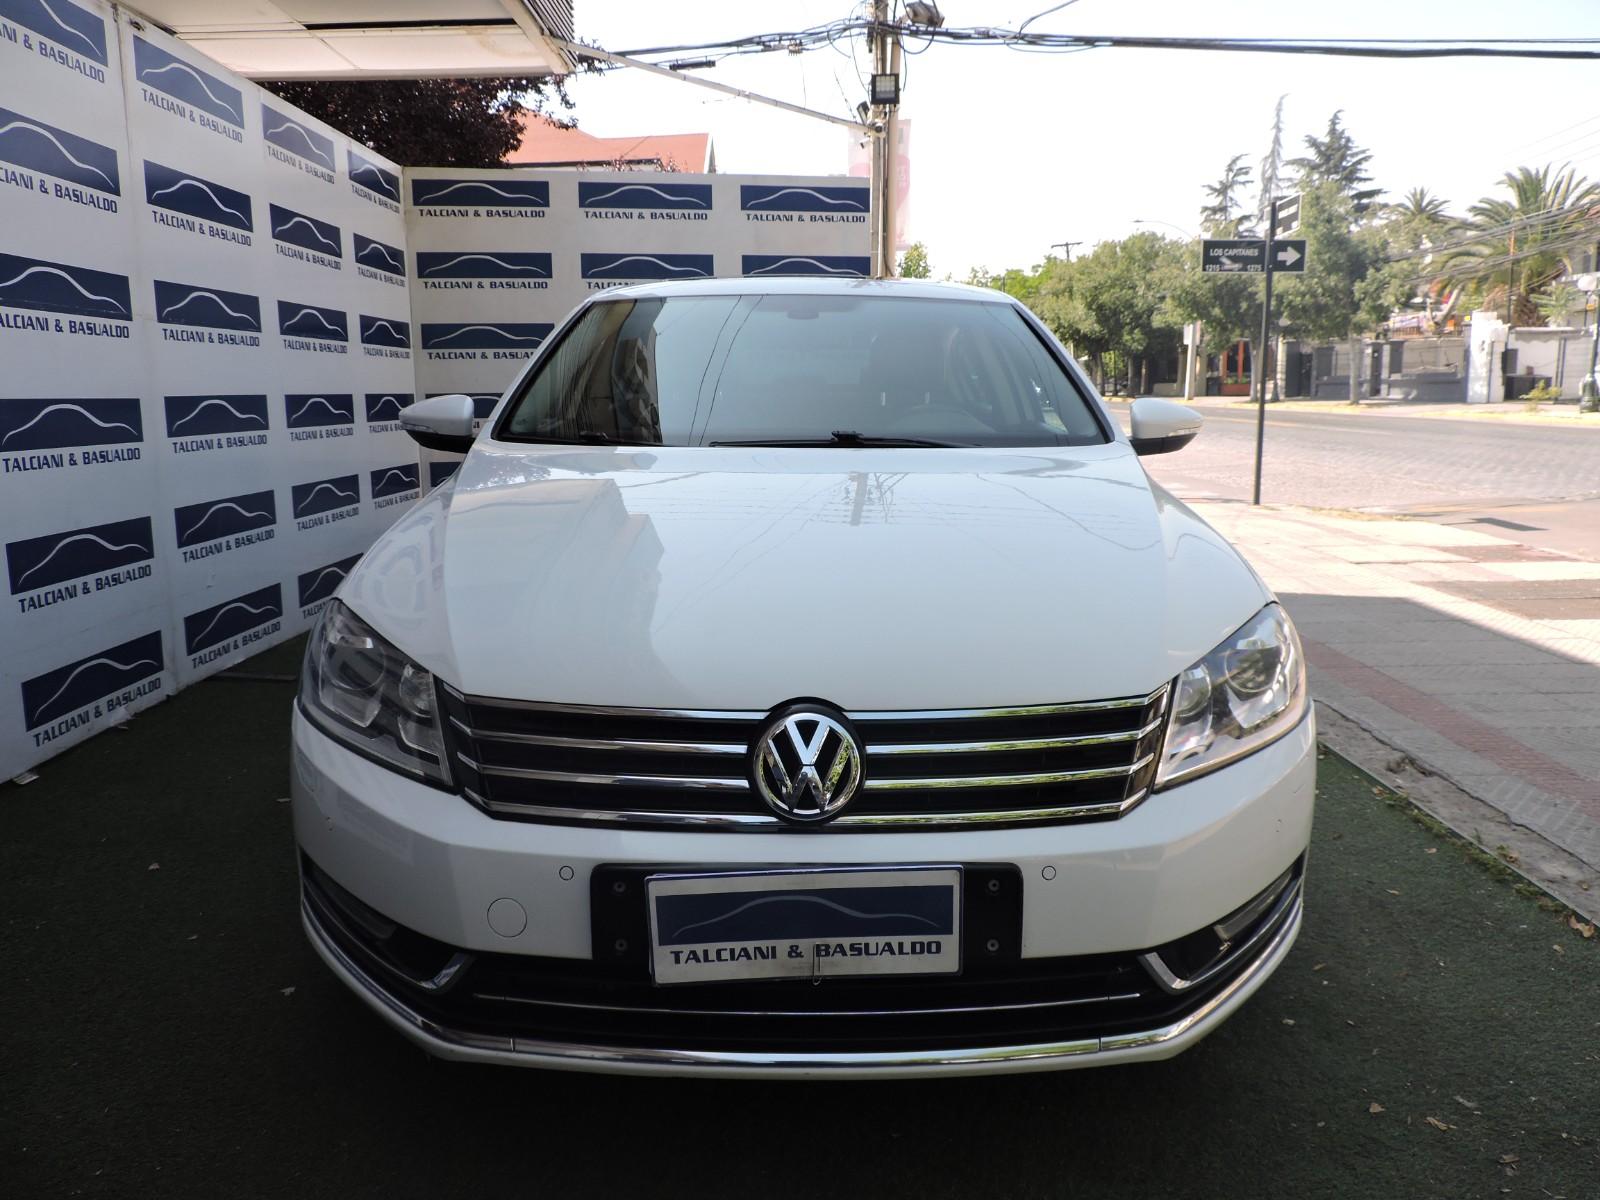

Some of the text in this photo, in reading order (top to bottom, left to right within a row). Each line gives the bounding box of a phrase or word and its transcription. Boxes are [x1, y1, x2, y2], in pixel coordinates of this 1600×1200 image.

[23, 34, 33, 51] &
[39, 41, 105, 83] BASUALDO
[142, 88, 243, 143] TALCIANI & BASUALDO
[267, 146, 335, 185] TALCIANI & BASUALDO
[39, 179, 49, 195] &
[55, 183, 117, 213] BASUALDO
[419, 208, 545, 218] TALCIANI & BASUALDO
[584, 210, 708, 221] TALCIANI & BASUALDO
[747, 213, 794, 222] TALCIANI
[810, 215, 866, 223] BASUALDO
[152, 211, 251, 246] TALCIANI & BASUALDO
[276, 244, 341, 271] TALCIANI & BASUALDO
[1210, 248, 1258, 256] LOS CAPITANES
[424, 281, 548, 289] TALCIANI & BASUALDO
[55, 319, 64, 333] &
[69, 320, 129, 339] BASUALDO
[162, 328, 260, 347] TALCIANI & BASUALDO
[284, 339, 348, 354] TALCIANI & BASUALDO
[428, 351, 534, 360] TALCIANI & BASUA
[172, 434, 267, 454] TALCIANI & BASUALDO
[290, 427, 354, 441] TALCIANI & BASUALDO
[3, 448, 141, 473] TALCIANI & BASUALDO
[297, 507, 359, 531] TALCIANI & BASUALDO
[182, 529, 275, 563] TALCIANI & BASUALDO
[19, 565, 152, 613] TALCIANI & BASUALDO
[191, 621, 280, 669] TALCIANI & BASUALDO
[33, 677, 161, 747] TALCIANI & BASUALDO
[670, 940, 942, 965] TALCIANI & BASUALDO
